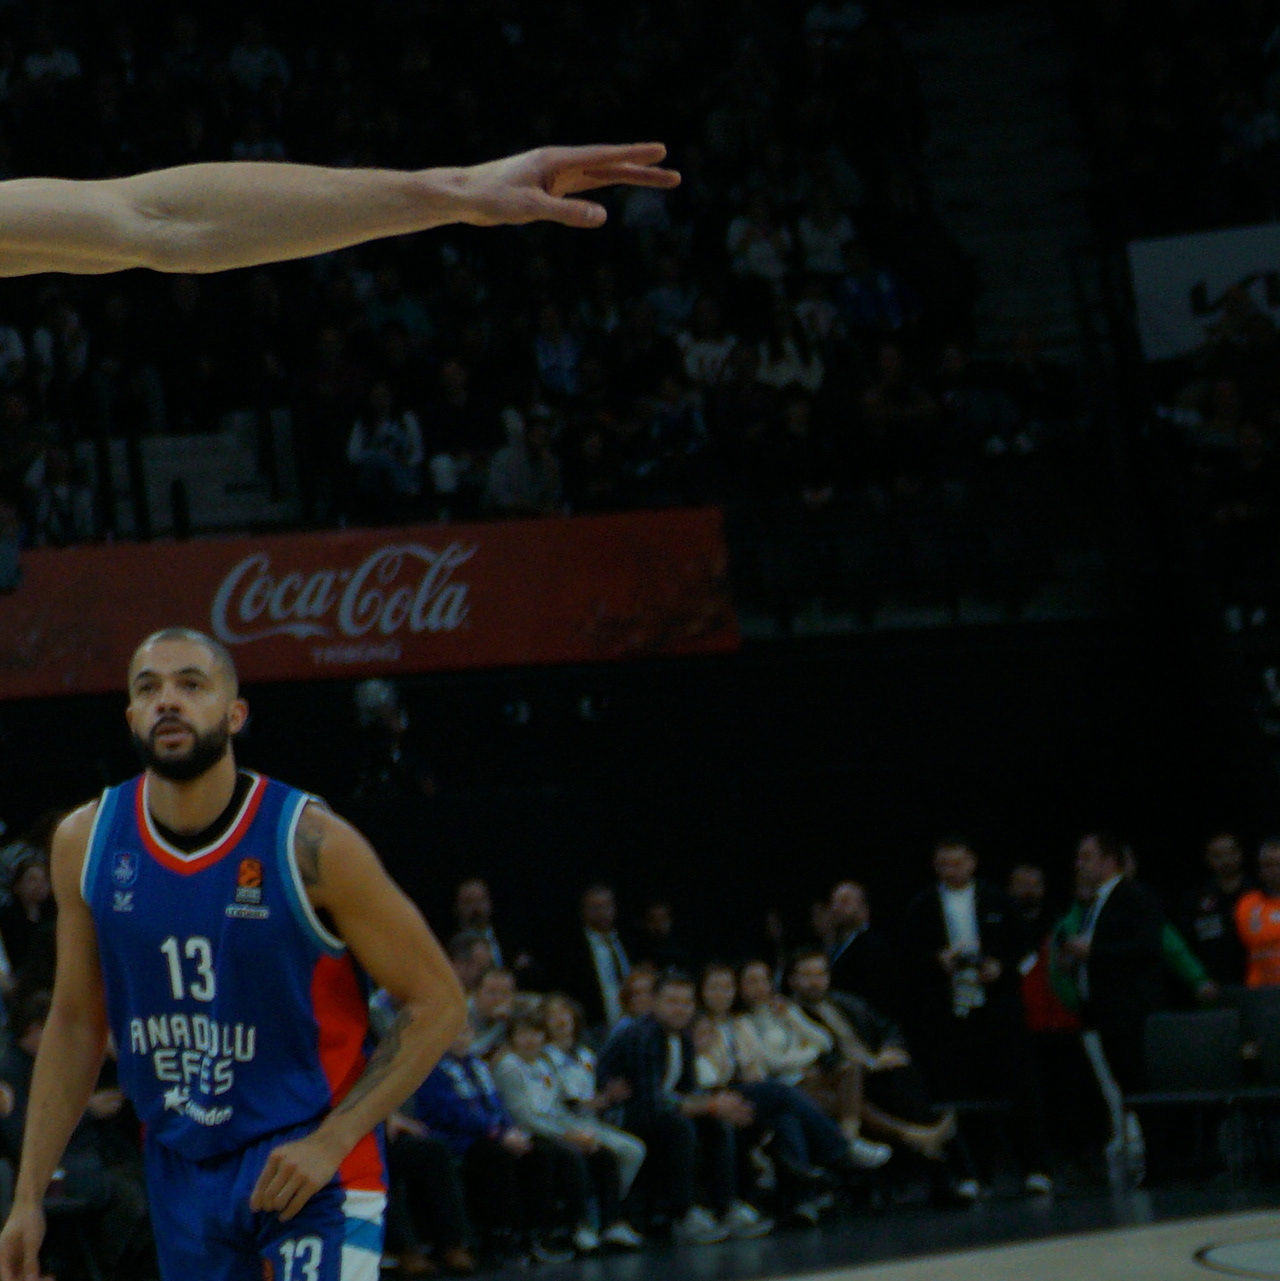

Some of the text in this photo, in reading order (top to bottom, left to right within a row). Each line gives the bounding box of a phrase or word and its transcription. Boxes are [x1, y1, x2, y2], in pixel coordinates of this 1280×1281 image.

[209, 541, 480, 644] Coca-Cola
[160, 934, 217, 1004] 13
[280, 1235, 324, 1281] 13
